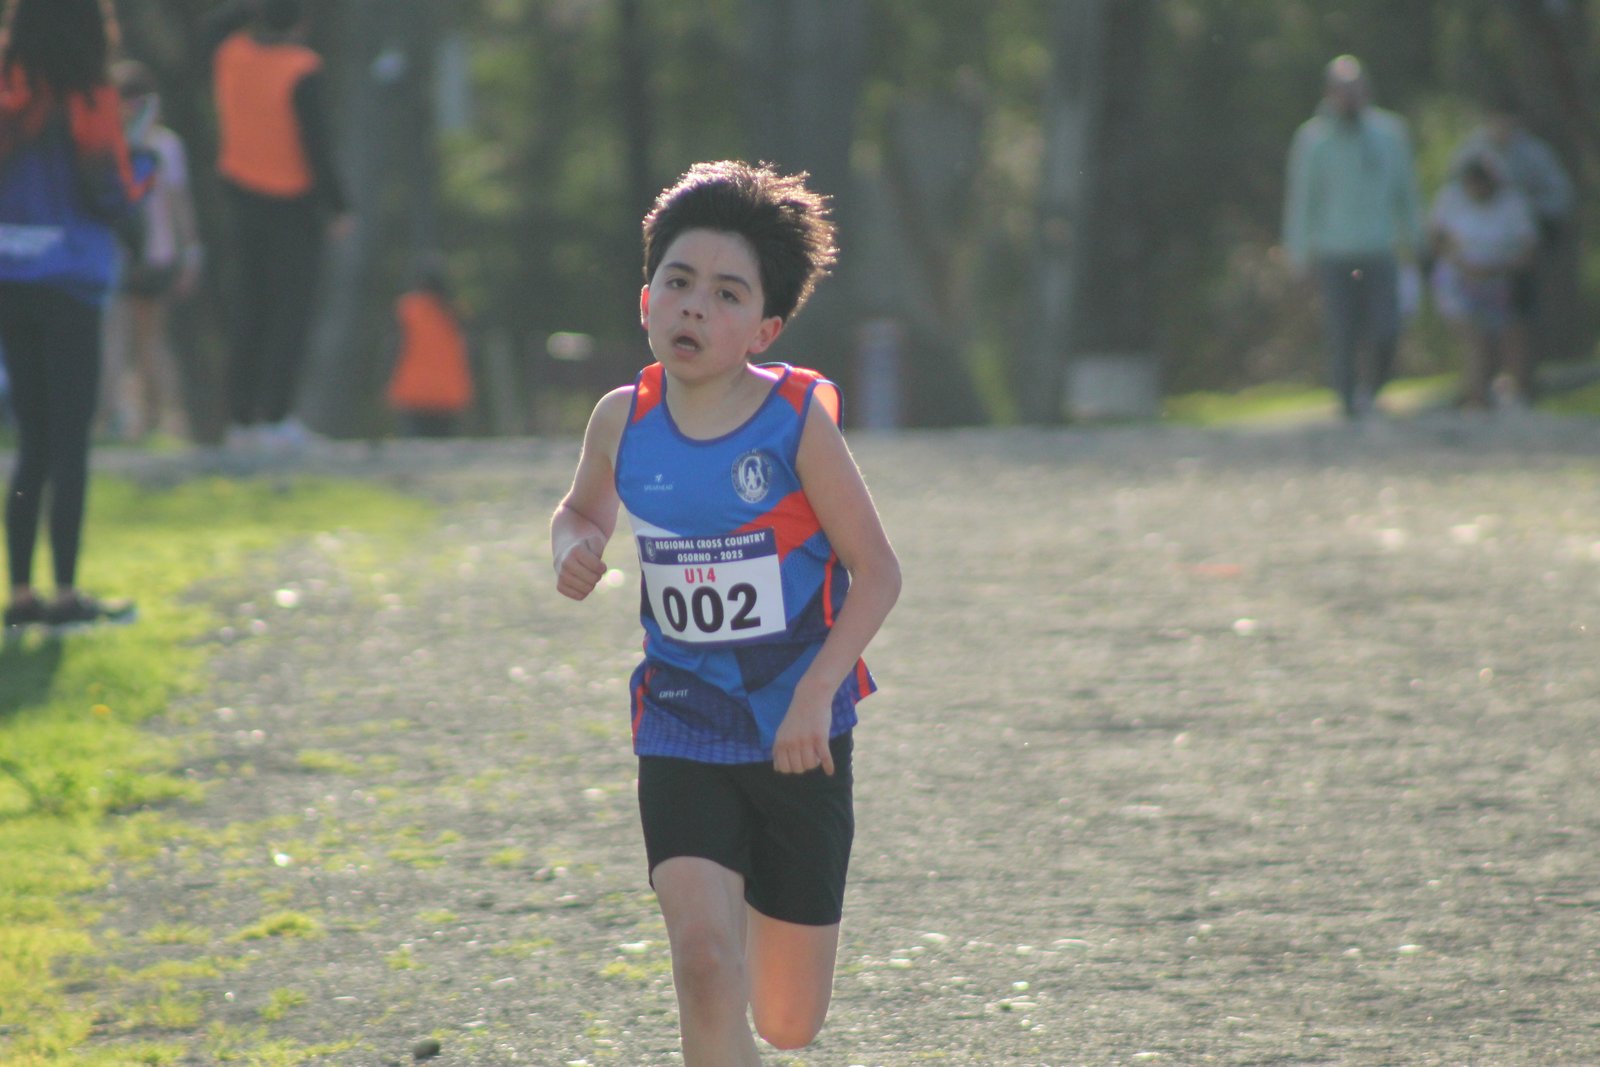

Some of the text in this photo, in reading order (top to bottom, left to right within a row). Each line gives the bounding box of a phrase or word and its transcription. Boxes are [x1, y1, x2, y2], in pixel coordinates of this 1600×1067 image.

[655, 539, 695, 550] REGIONAL
[696, 539, 722, 549] CROSS
[725, 532, 766, 547] COUNTRY
[677, 553, 711, 562] OSORNO
[720, 550, 743, 560] 2025
[684, 567, 716, 584] U14
[662, 582, 761, 633] 002
